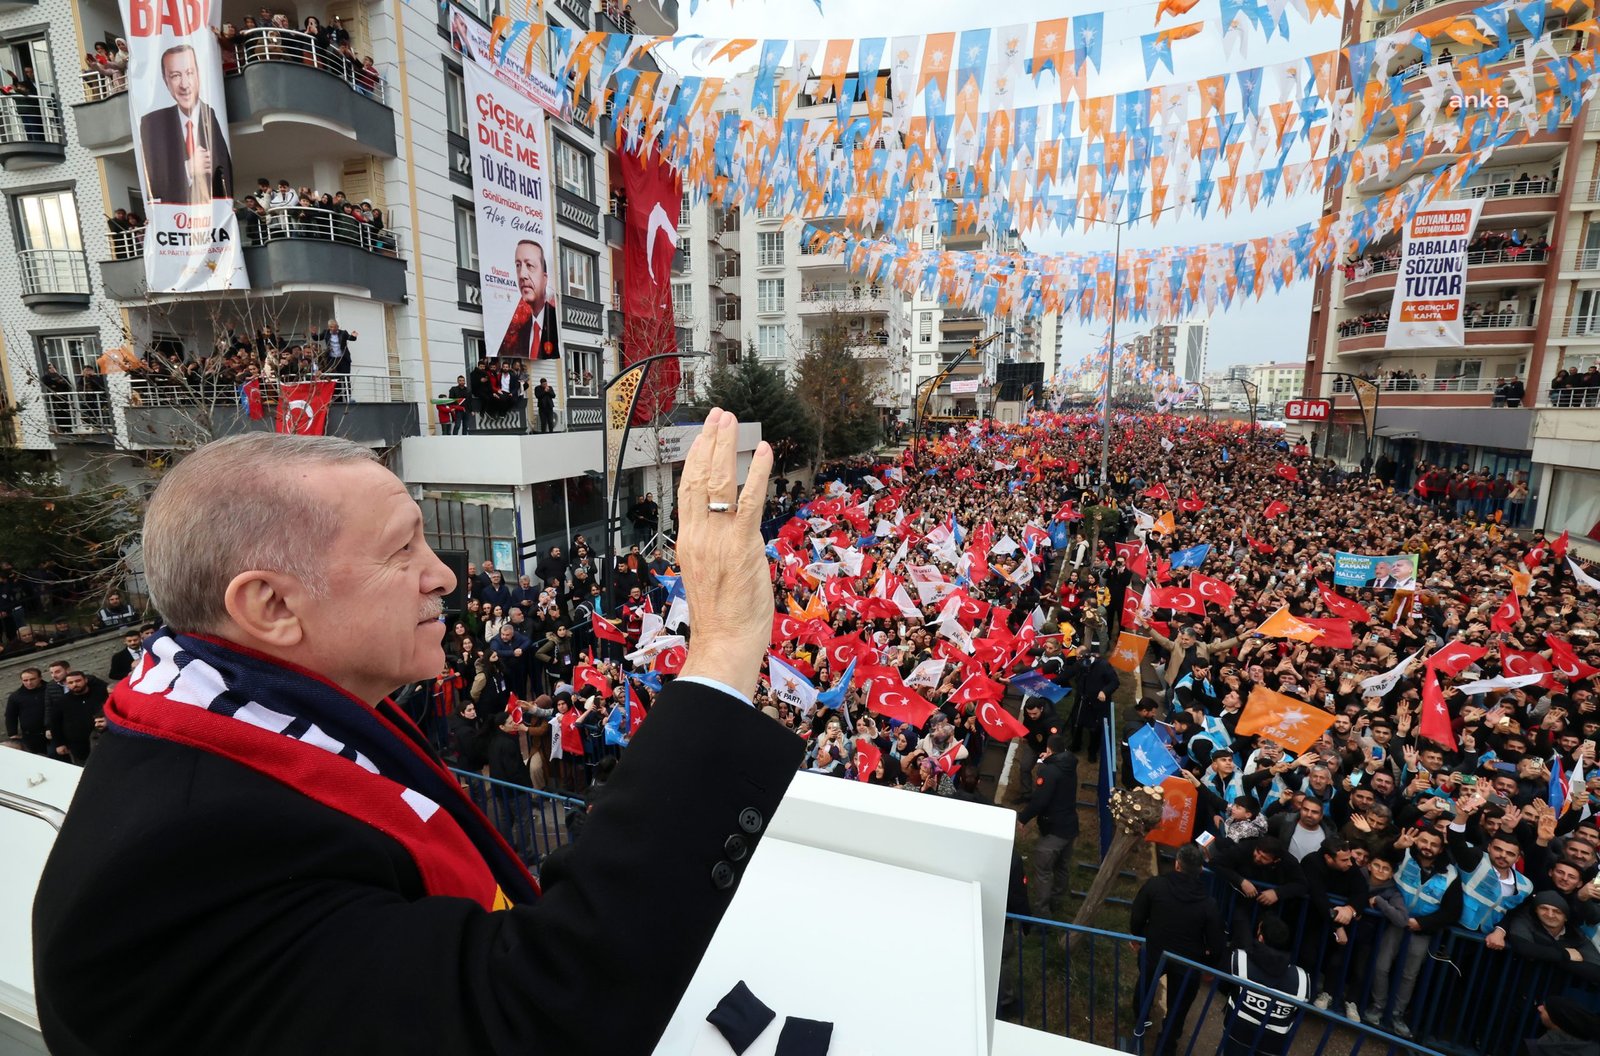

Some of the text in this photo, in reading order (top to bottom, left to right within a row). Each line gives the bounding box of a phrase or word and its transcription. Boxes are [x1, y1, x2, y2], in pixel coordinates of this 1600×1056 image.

[516, 143, 540, 170] ME
[483, 206, 506, 227] Hoş
[1416, 213, 1466, 226] DUYANLARA
[1415, 224, 1465, 234] DUYMAYANLARA
[1408, 239, 1468, 256] BABALAR
[1405, 275, 1462, 297] TUTAR
[1418, 303, 1455, 312] GENÇLİK
[1290, 401, 1324, 416] BİM
[1246, 995, 1291, 1016] POİS
